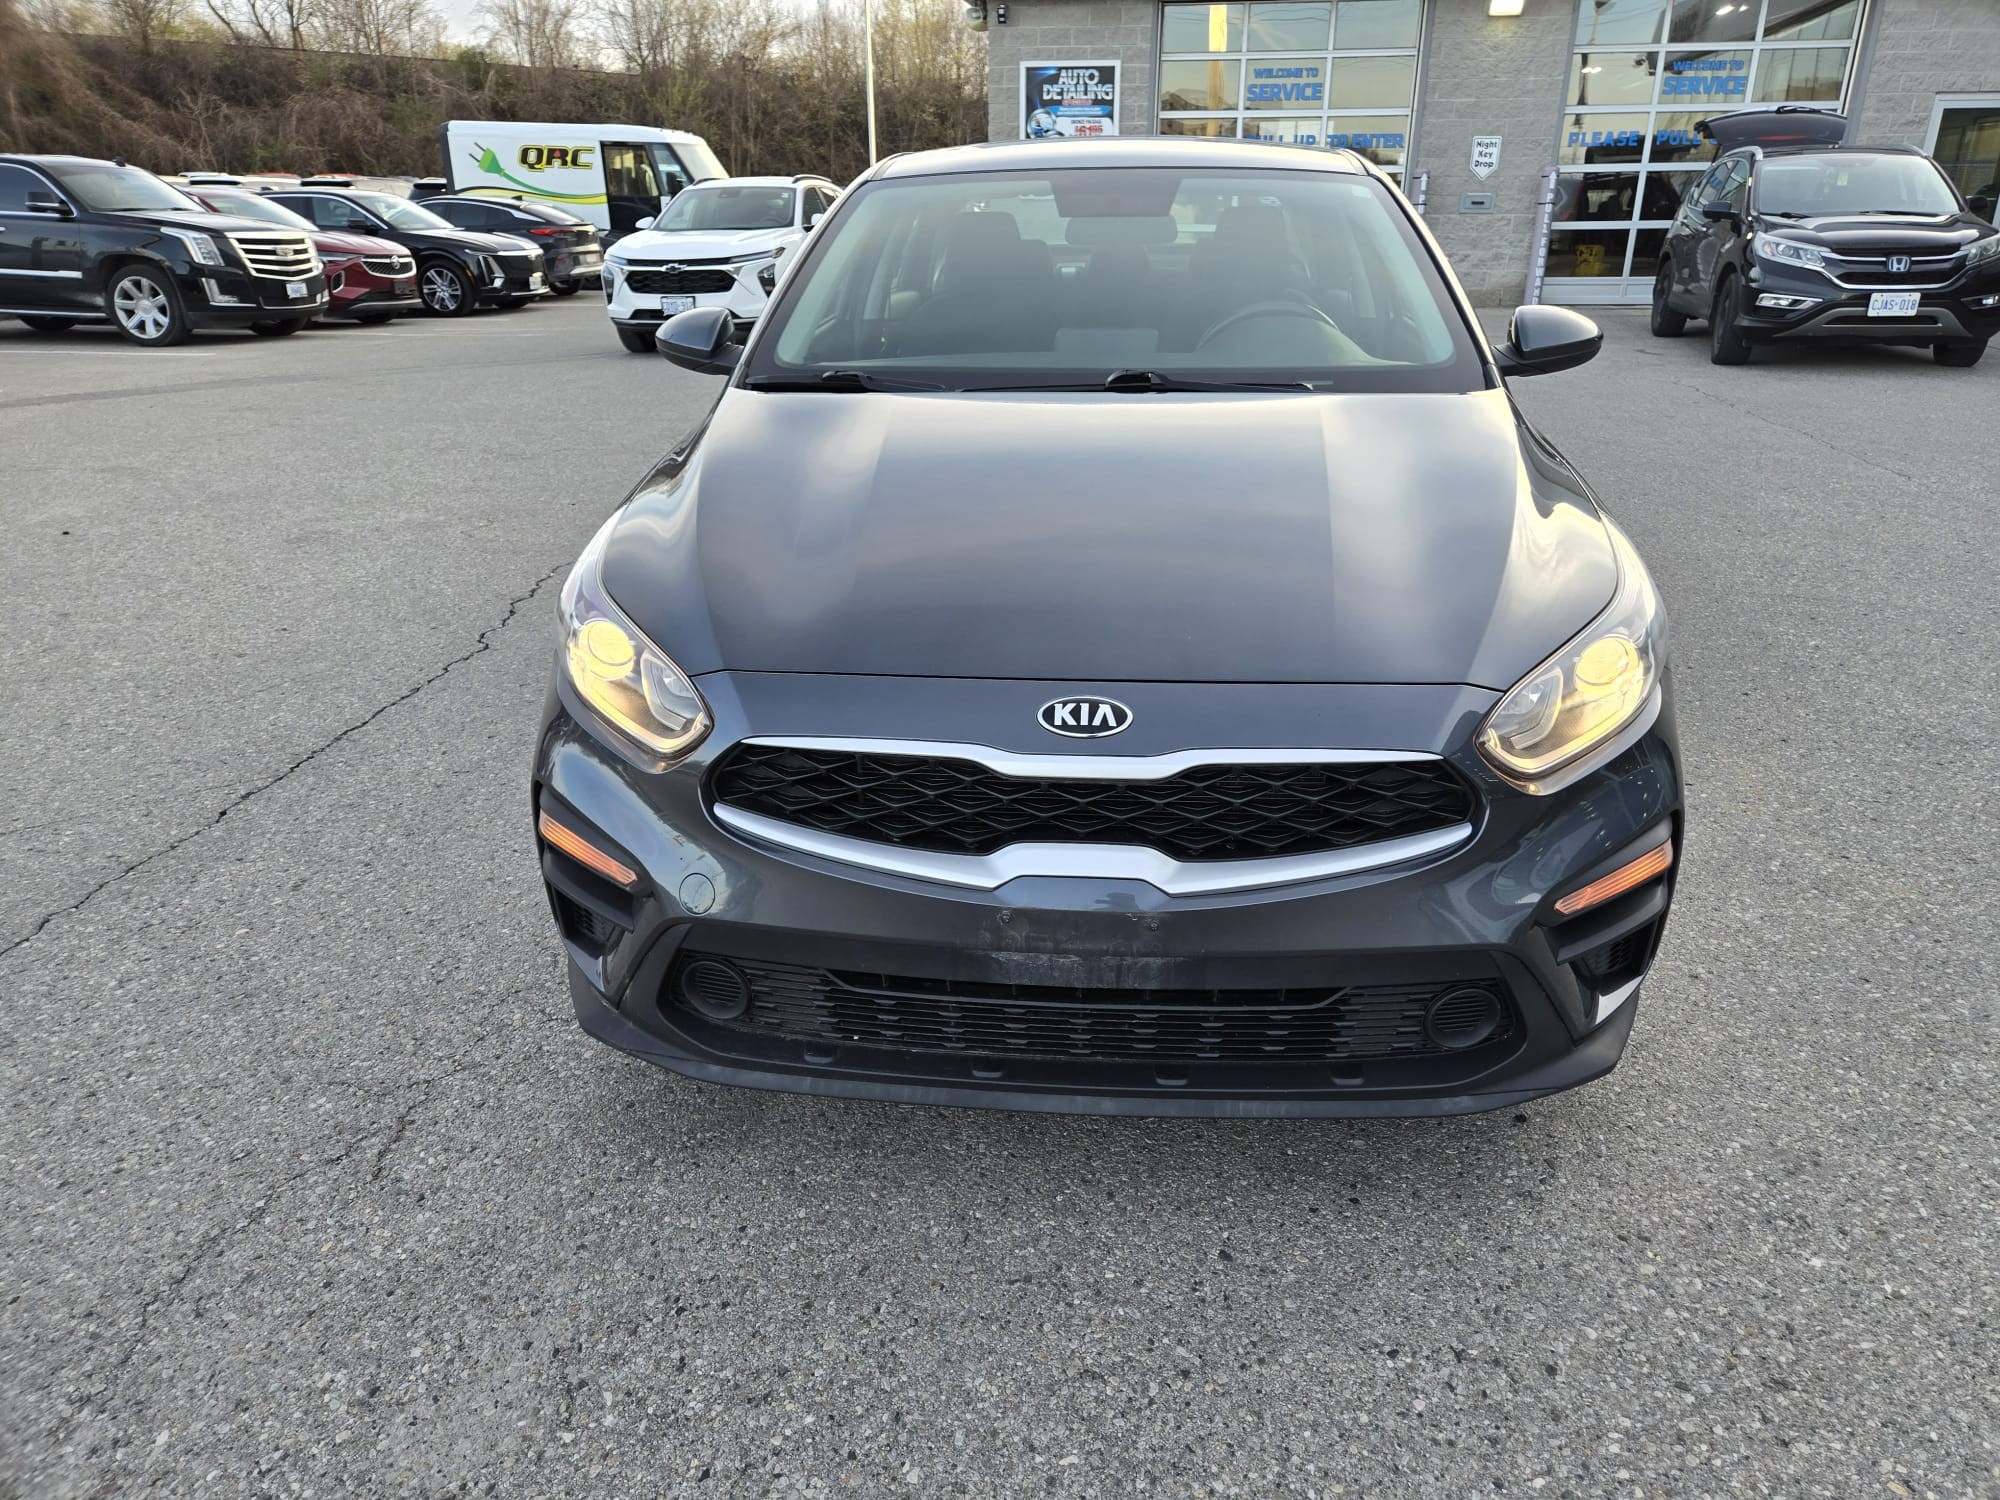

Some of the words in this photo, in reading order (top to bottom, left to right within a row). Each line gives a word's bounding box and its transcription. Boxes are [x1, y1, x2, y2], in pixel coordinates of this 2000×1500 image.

[1253, 68, 1304, 79] WELCOME
[1305, 67, 1319, 78] TO
[1672, 60, 1728, 71] WELCOME
[1729, 60, 1745, 71] TO
[1058, 68, 1100, 85] AUTO
[1042, 84, 1114, 100] DETAILING
[1247, 83, 1323, 101] SERVICE
[1663, 76, 1747, 95] SERVICE
[1327, 135, 1348, 148] TO
[1351, 134, 1404, 148] ENTER
[1476, 141, 1498, 149] Night
[1568, 131, 1640, 147] PLEASE
[1656, 130, 1702, 145] PULL
[519, 145, 595, 172] QRC
[1478, 150, 1493, 159] Key
[1474, 160, 1494, 168] Drop
[1053, 702, 1117, 727] KIA
